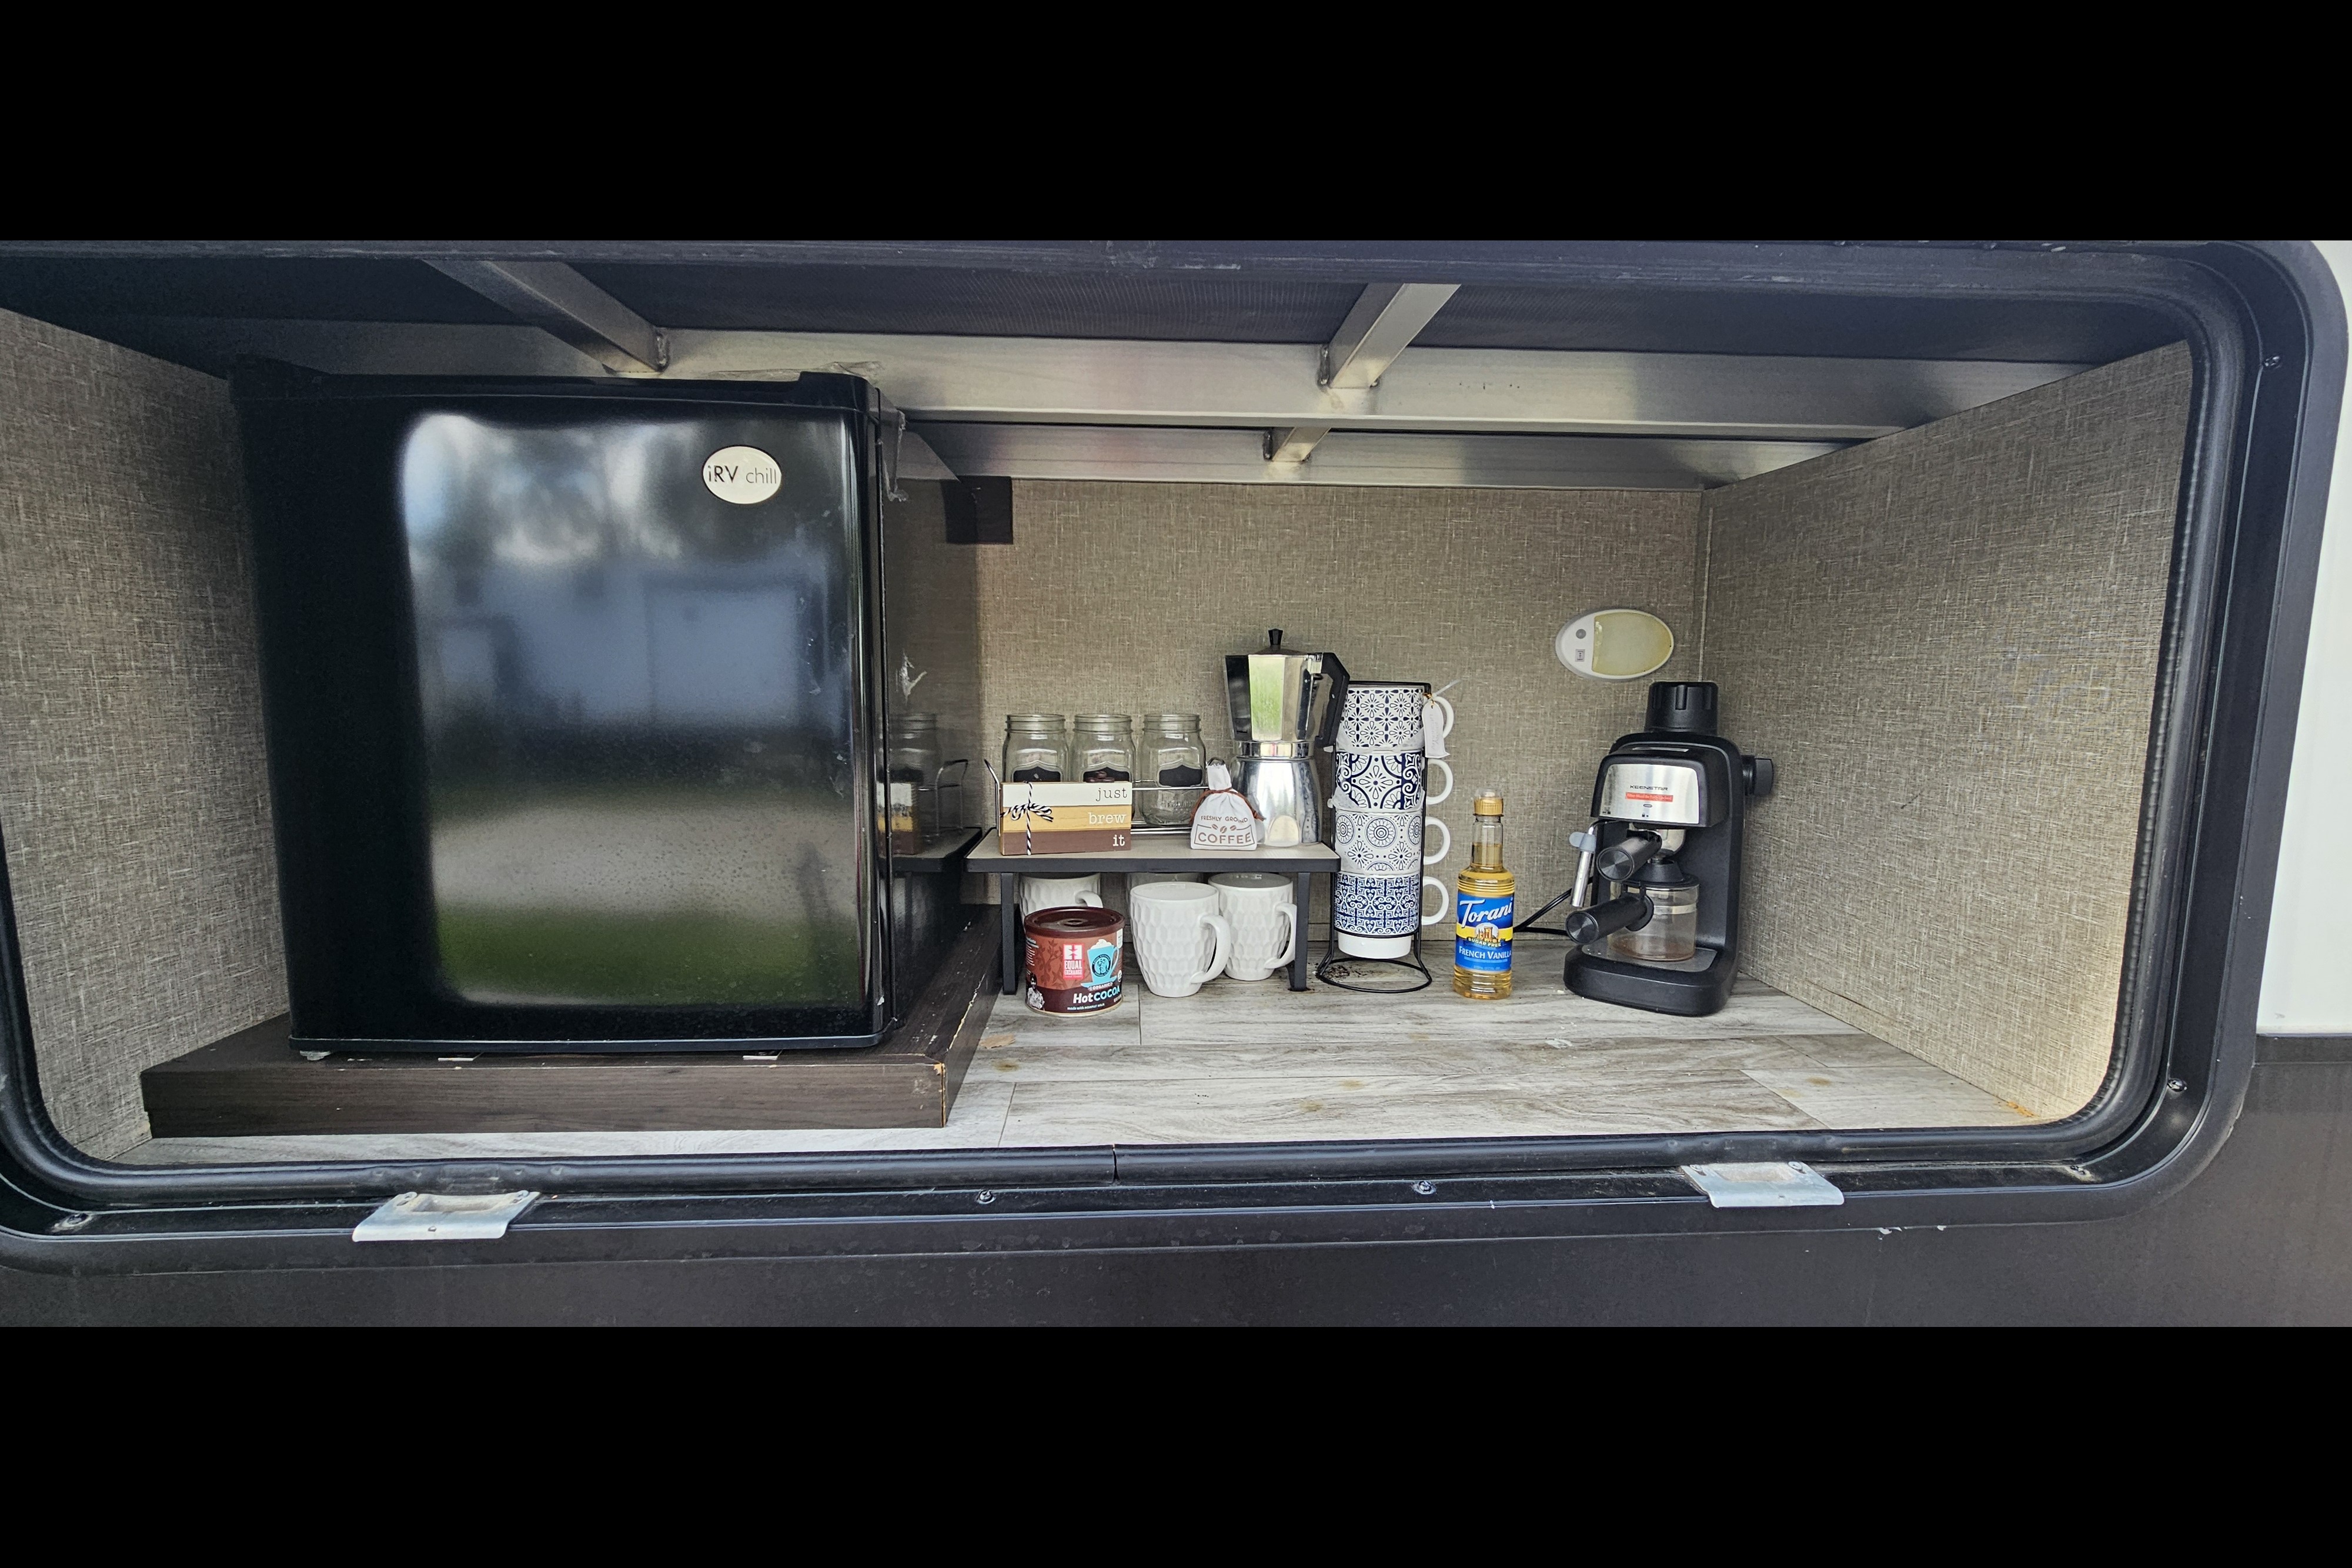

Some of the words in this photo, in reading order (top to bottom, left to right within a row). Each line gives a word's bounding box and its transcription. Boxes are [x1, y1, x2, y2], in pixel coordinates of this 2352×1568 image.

[707, 465, 739, 483] iRV
[746, 467, 777, 484] chill
[1095, 787, 1128, 801] just
[1088, 812, 1127, 824] brew
[1112, 834, 1125, 847] it
[1198, 831, 1251, 844] COFFEE
[1459, 897, 1513, 928] Torani
[1468, 937, 1486, 946] SUGAR
[1459, 945, 1485, 959] FRENCH
[1064, 960, 1083, 969] EQUAL
[1073, 992, 1094, 1004] Hot
[1094, 985, 1120, 1001] COCOA
